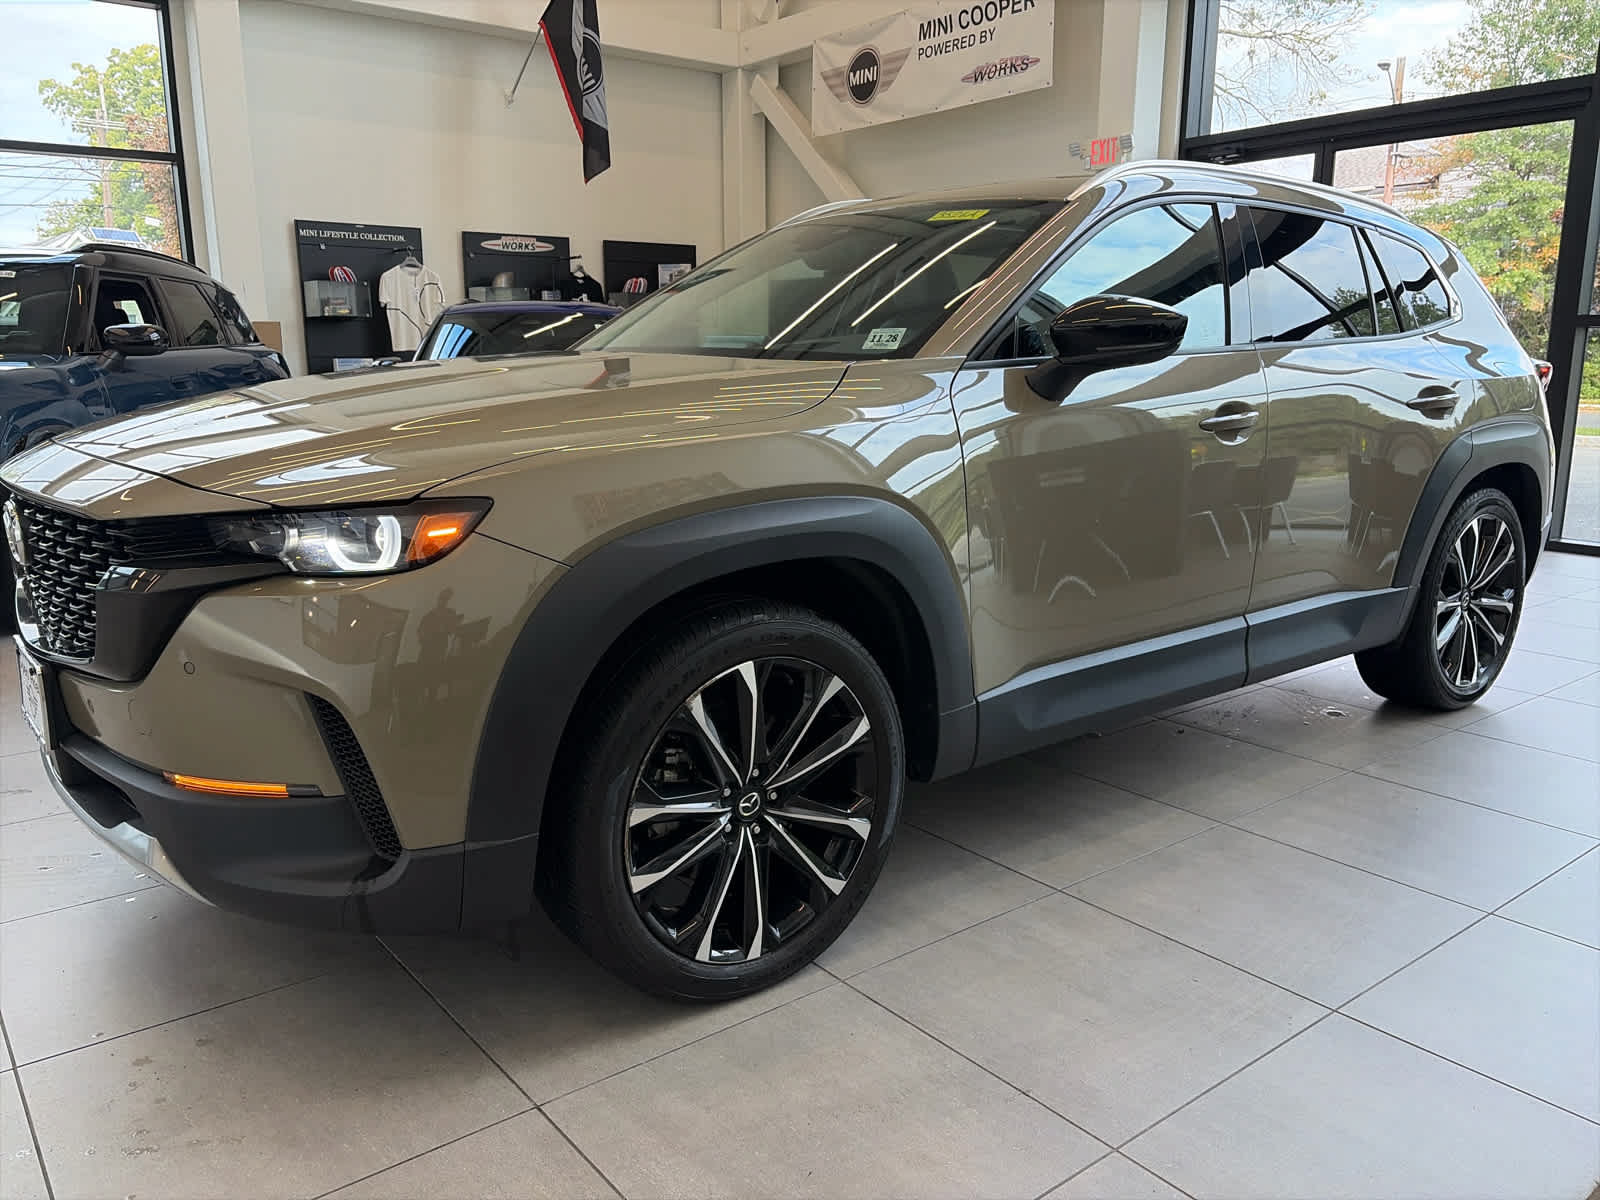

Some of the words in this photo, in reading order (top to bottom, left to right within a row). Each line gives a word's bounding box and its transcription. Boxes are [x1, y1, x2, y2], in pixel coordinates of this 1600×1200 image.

[918, 14, 953, 41] MINI
[918, 33, 976, 60] POWERED
[980, 27, 996, 44] BY
[850, 65, 877, 87] MINI
[973, 57, 1030, 83] WORKS
[1091, 137, 1118, 165] EXIT
[299, 228, 318, 237] MINI
[319, 229, 359, 241] LIFESTYLE
[501, 241, 536, 251] WORKS
